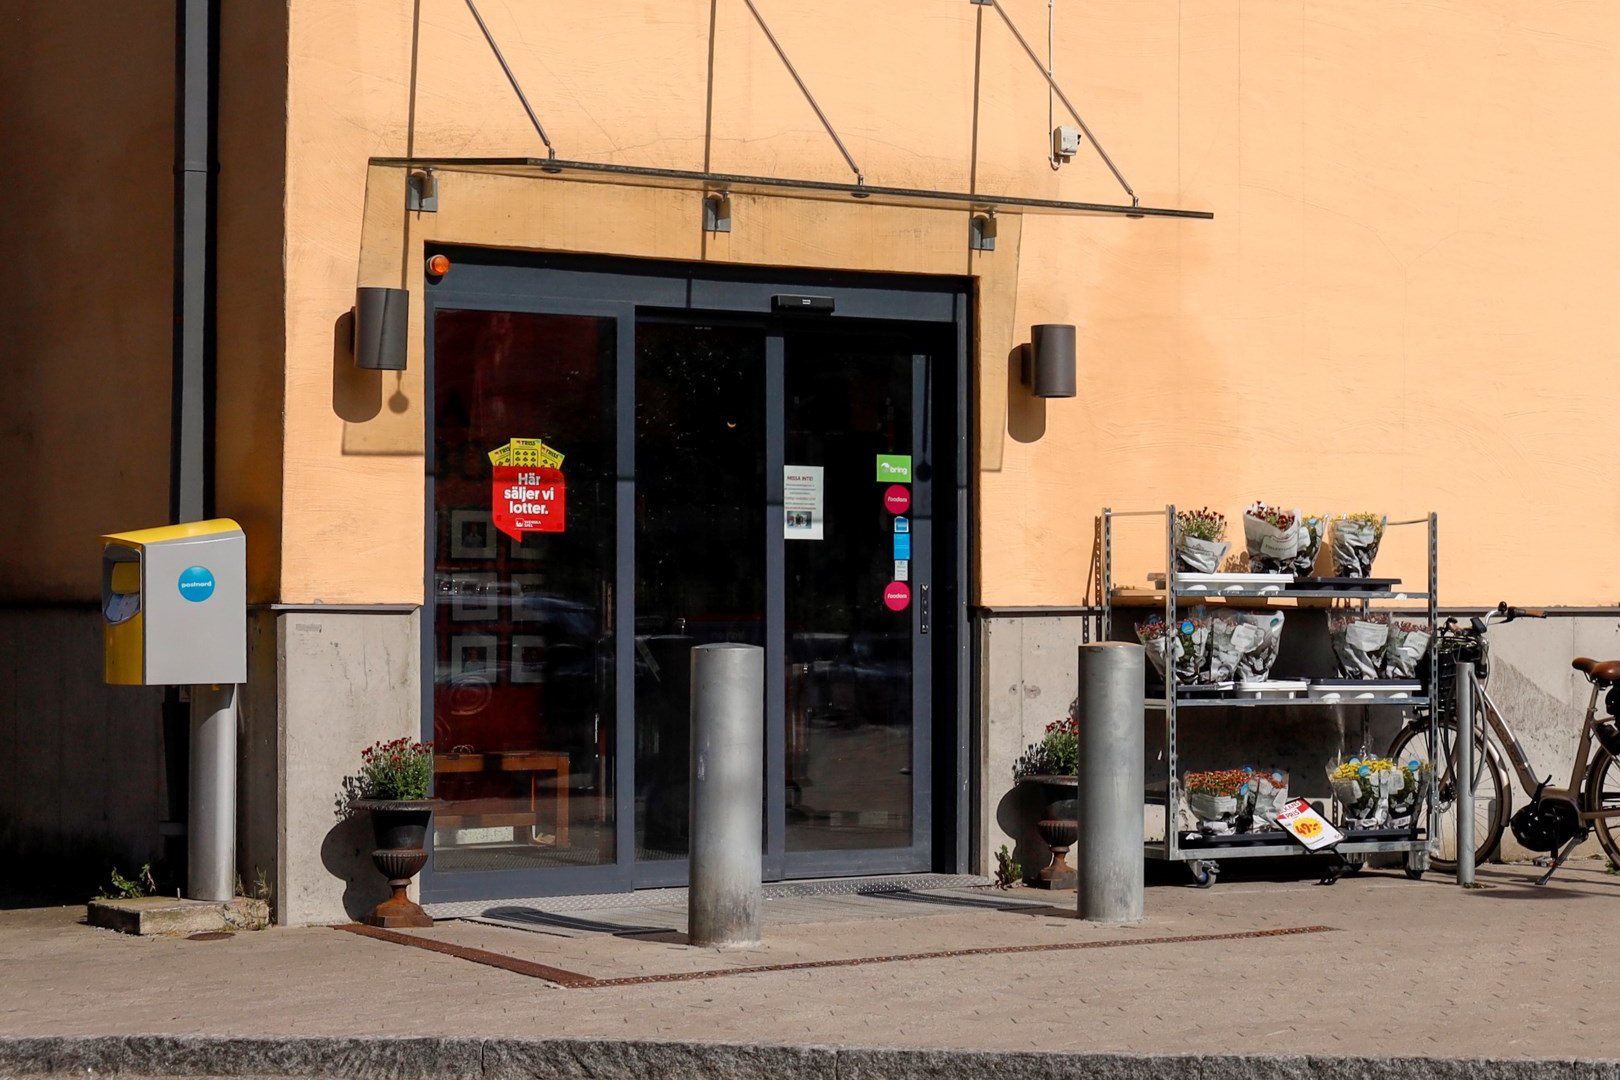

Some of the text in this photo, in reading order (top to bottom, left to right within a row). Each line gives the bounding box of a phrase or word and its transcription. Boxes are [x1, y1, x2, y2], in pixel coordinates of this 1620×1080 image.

[890, 466, 908, 475] bring
[518, 472, 541, 486] Här
[504, 486, 554, 502] säljer vi
[509, 500, 549, 515] lotter.
[181, 580, 212, 589] postnord
